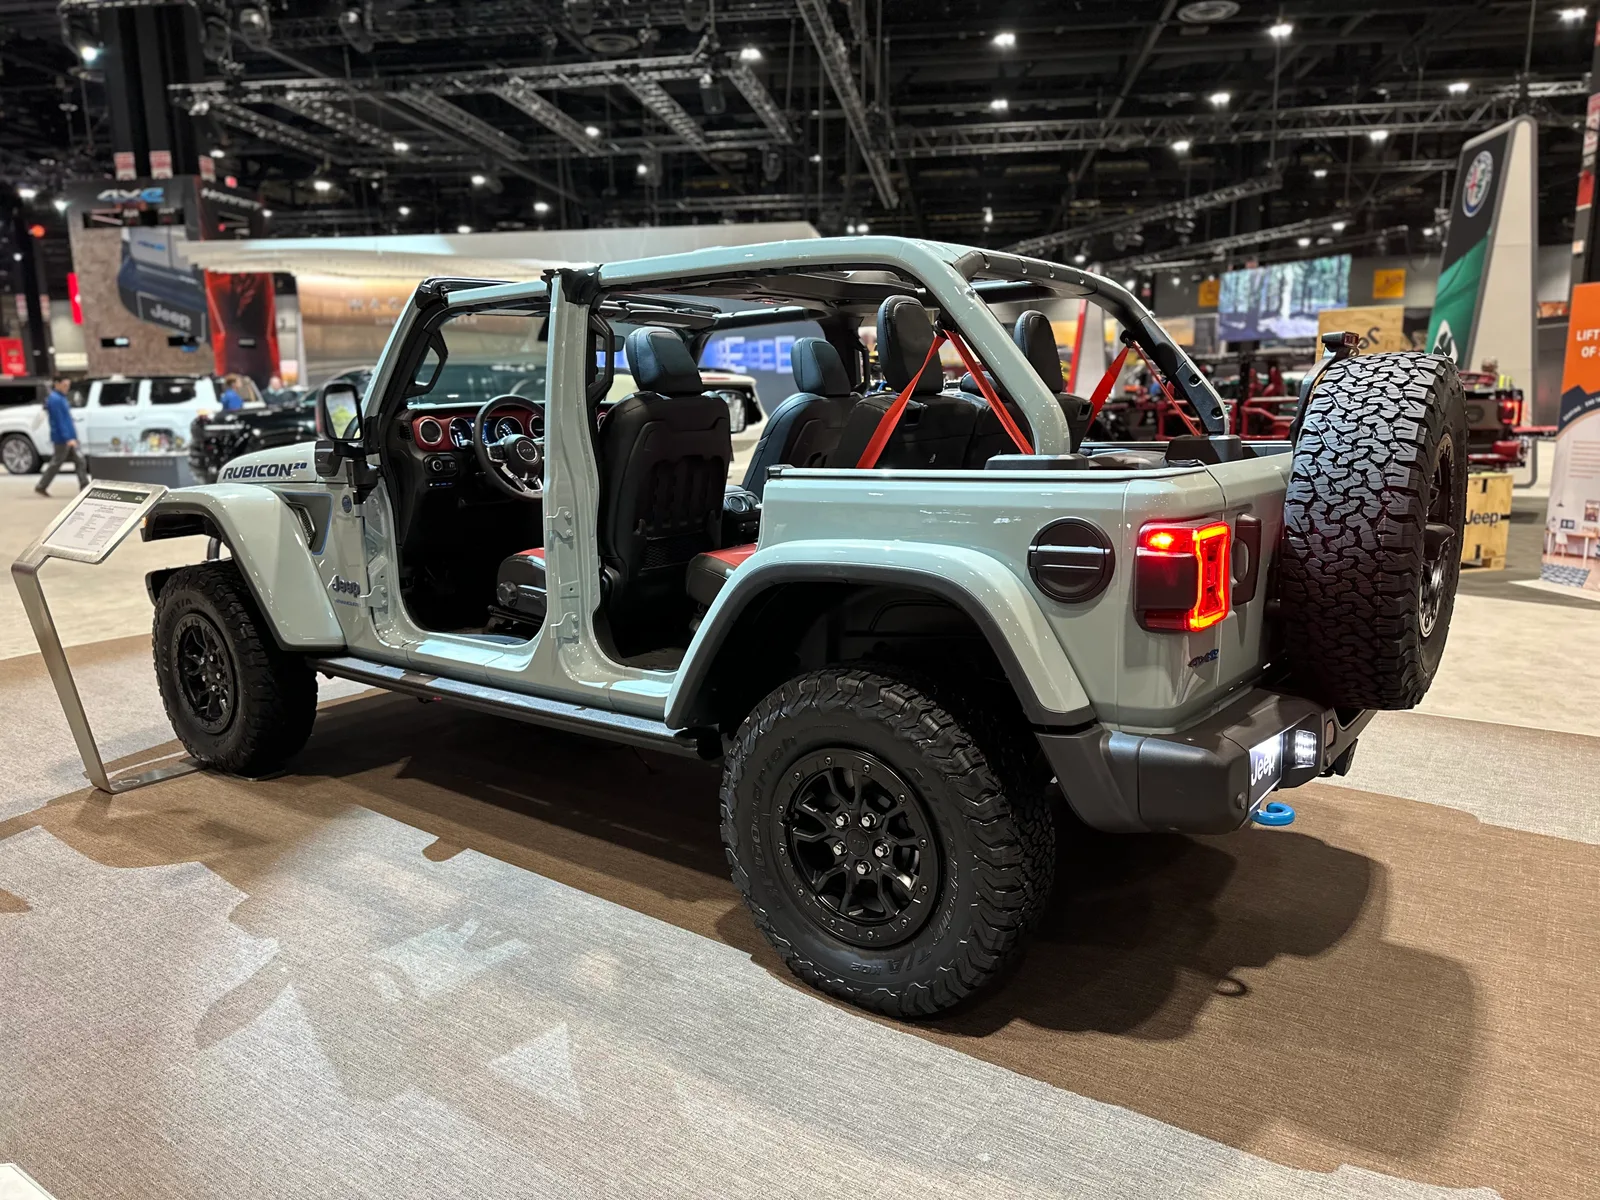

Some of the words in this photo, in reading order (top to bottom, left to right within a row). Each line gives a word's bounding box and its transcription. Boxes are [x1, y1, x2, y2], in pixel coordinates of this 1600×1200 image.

[223, 463, 293, 479] RUBICON
[1465, 509, 1499, 528] Jeep
[332, 575, 361, 598] Jeep
[1250, 753, 1276, 787] Jeep
